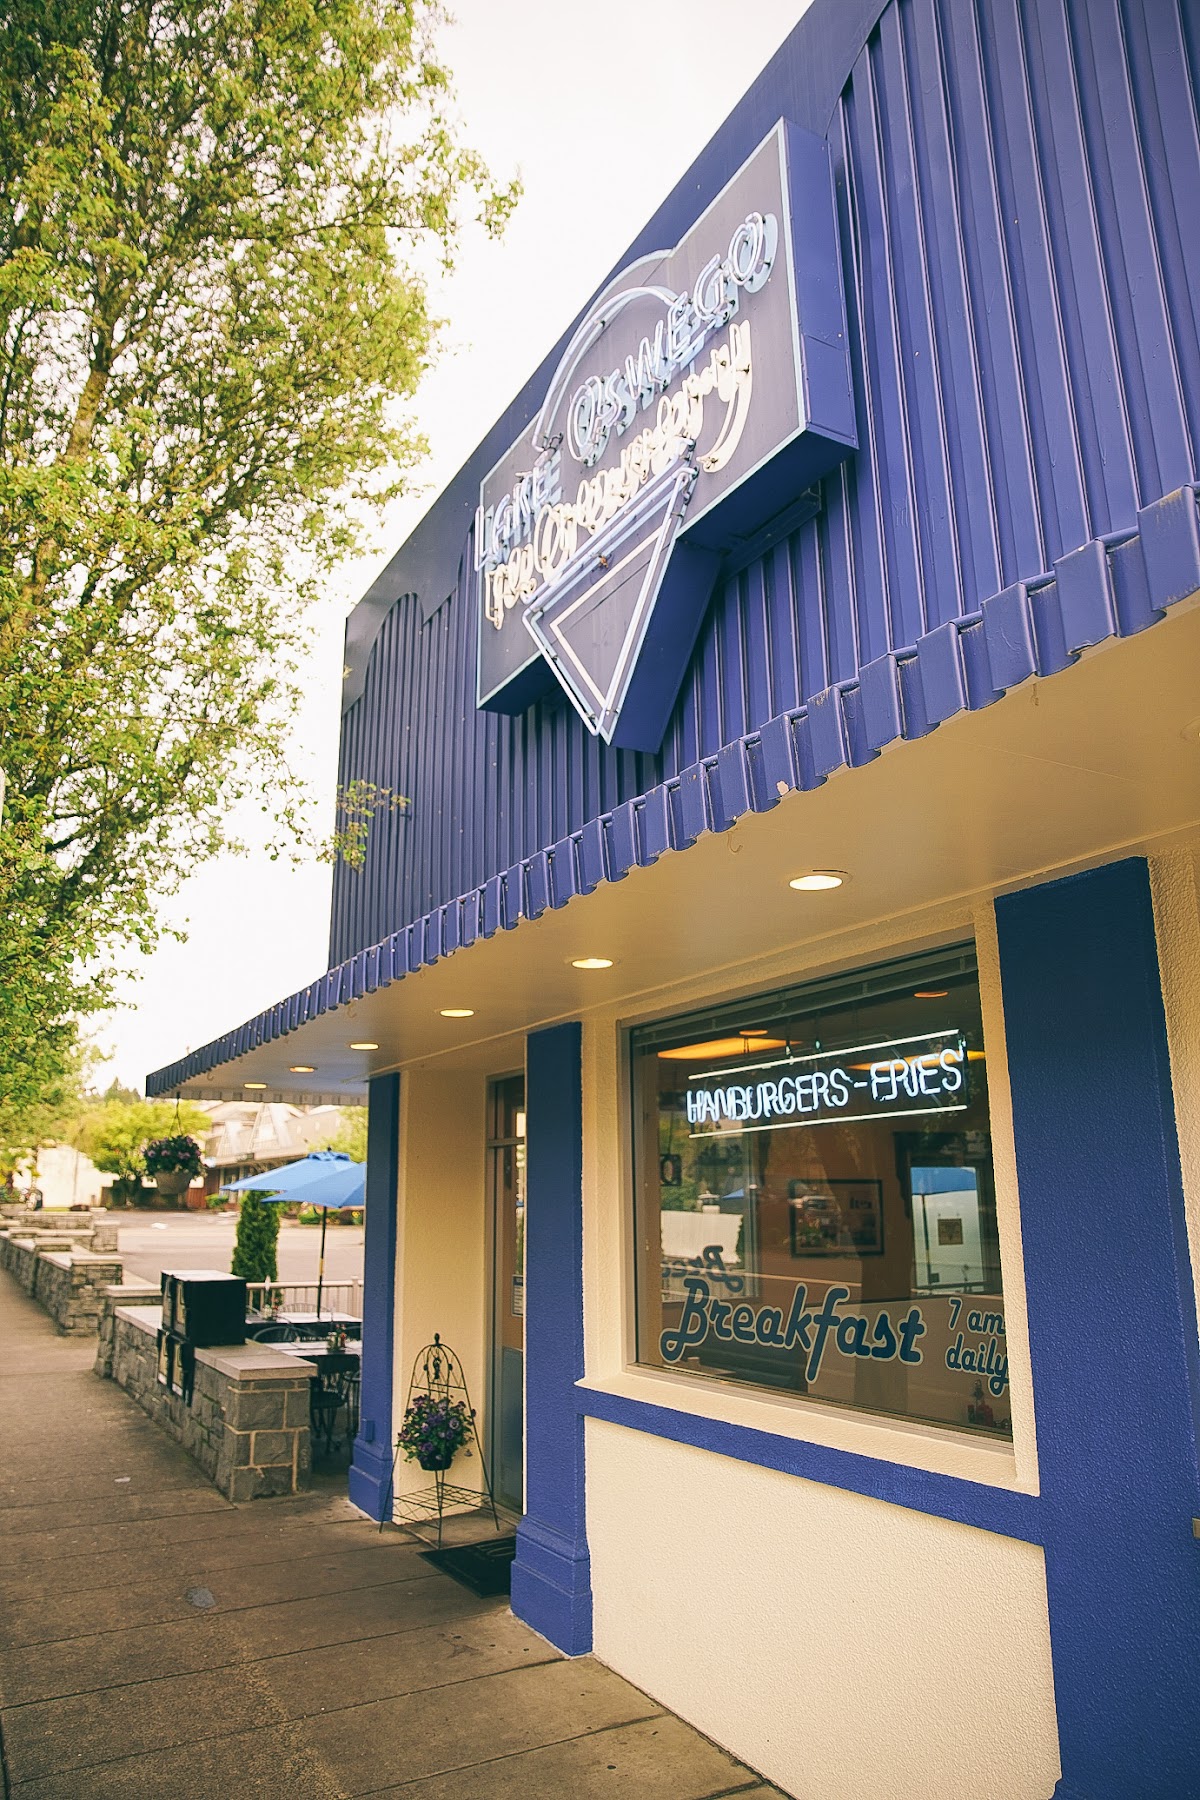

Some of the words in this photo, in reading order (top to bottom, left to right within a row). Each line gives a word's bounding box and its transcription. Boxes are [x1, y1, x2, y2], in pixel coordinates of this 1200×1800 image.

[475, 449, 562, 573] LAKE
[567, 212, 778, 468] OSWEGO
[660, 1278, 926, 1384] Breakfast
[948, 1297, 963, 1331] 7
[967, 1310, 1006, 1337] am
[945, 1332, 1009, 1397] daily
